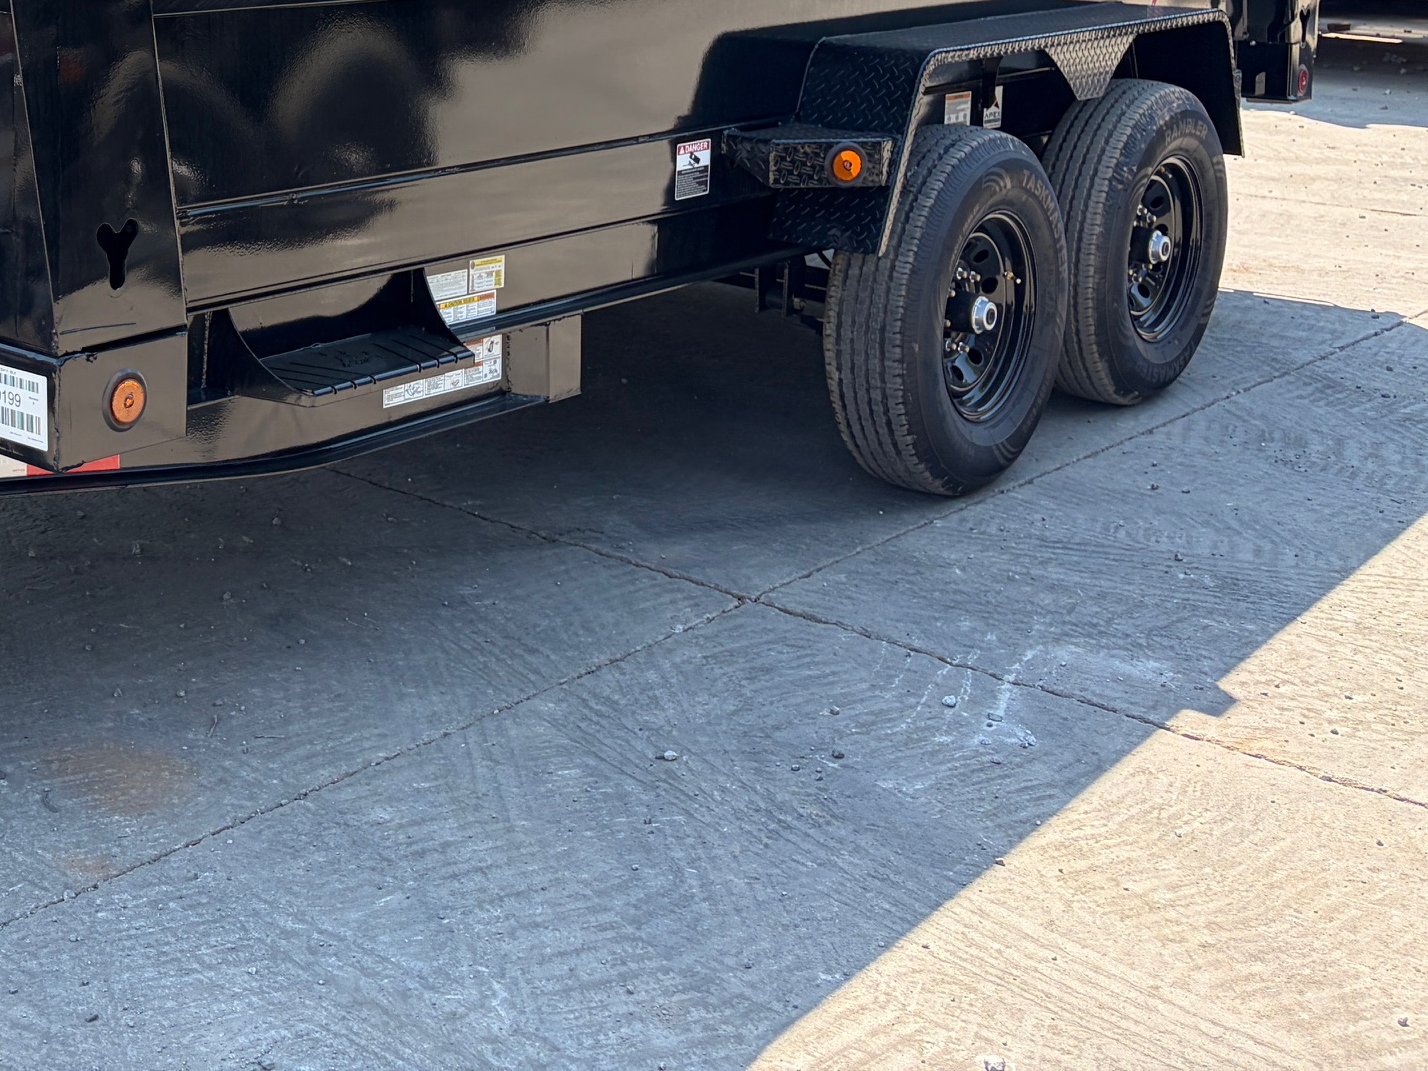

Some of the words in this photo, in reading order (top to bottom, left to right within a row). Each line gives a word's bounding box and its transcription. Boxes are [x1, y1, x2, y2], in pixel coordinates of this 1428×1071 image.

[1165, 118, 1208, 146] RAMBLER
[685, 141, 708, 153] DANGER
[1022, 169, 1068, 279] TASKMASTER
